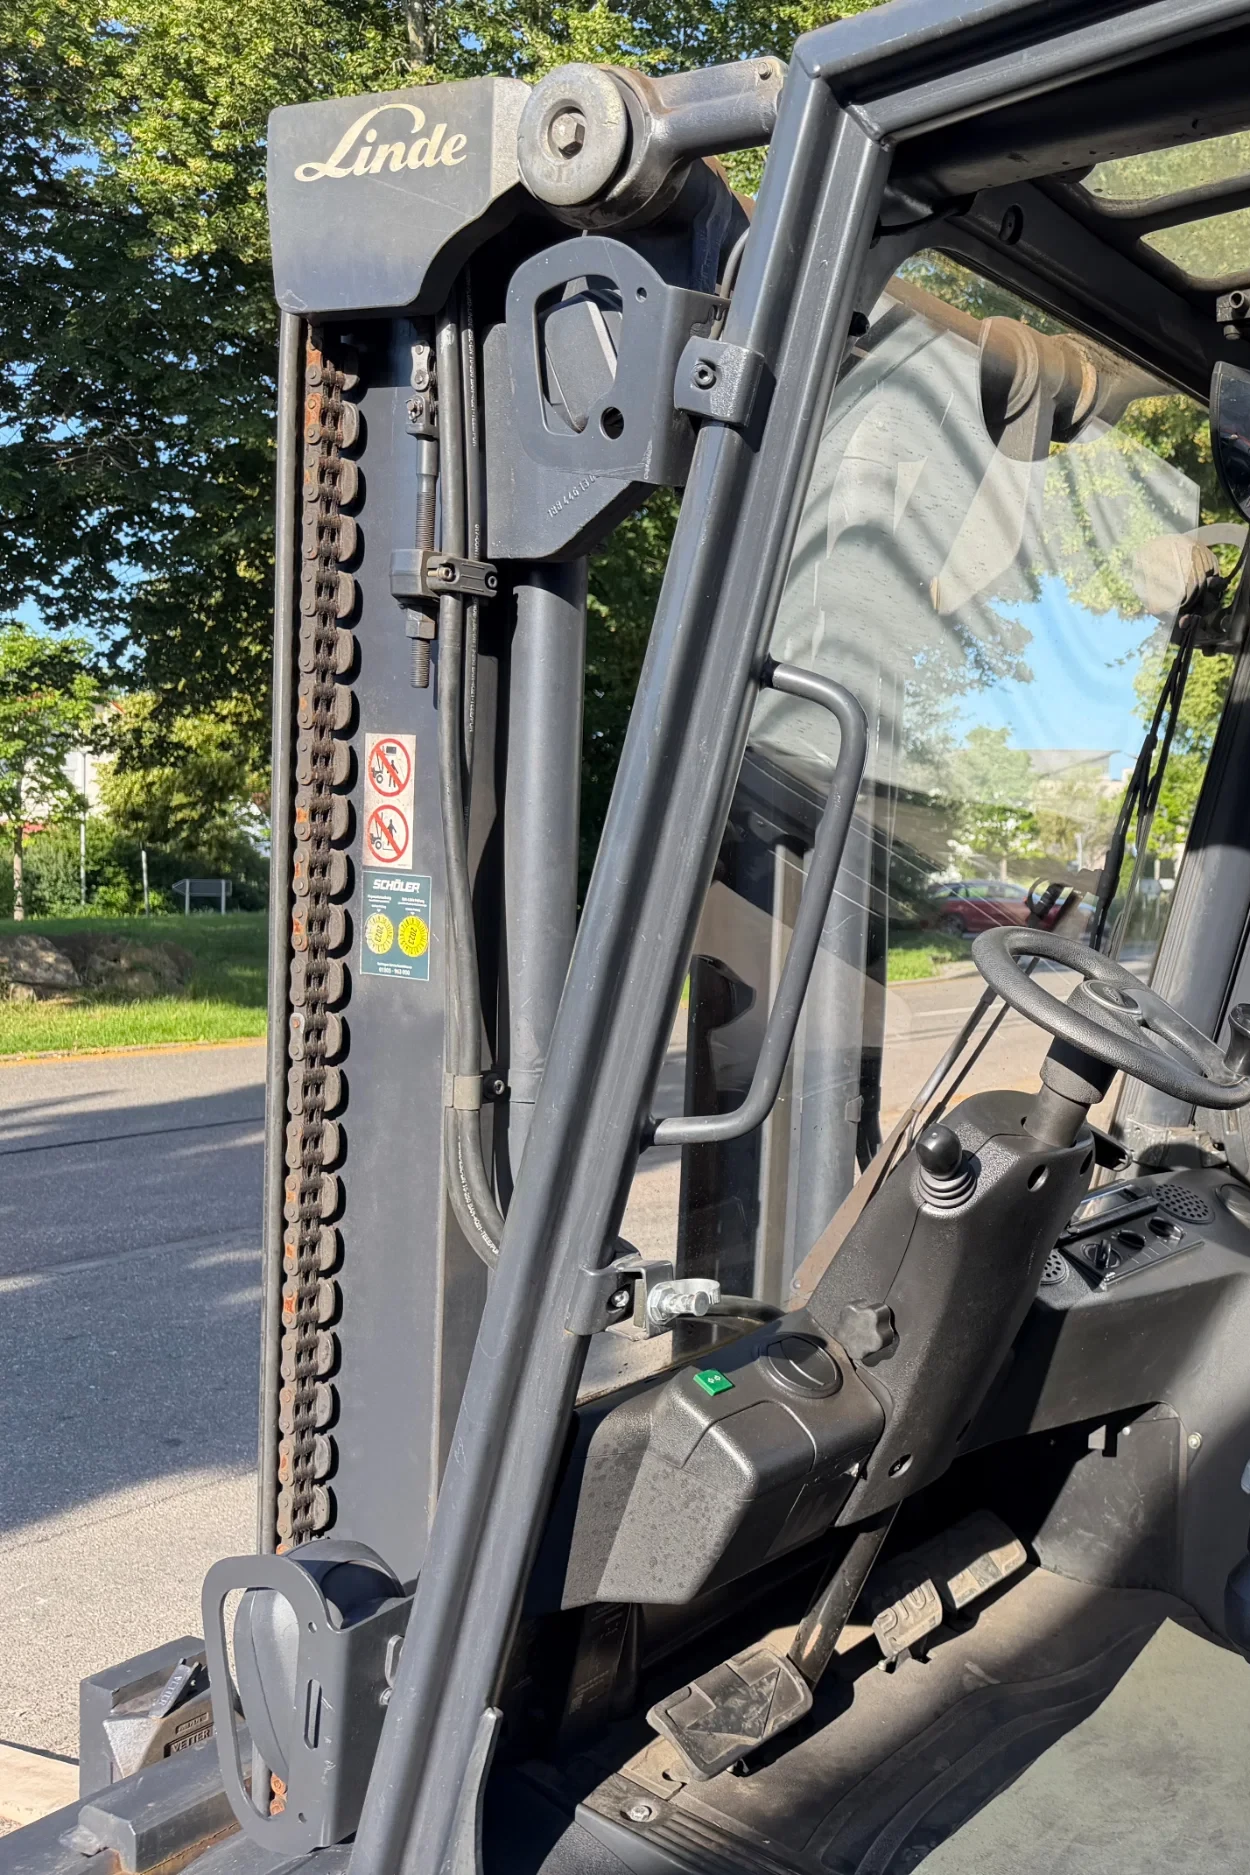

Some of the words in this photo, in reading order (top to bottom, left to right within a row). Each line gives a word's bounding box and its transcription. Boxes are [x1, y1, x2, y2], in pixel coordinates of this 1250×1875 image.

[294, 103, 467, 182] Linde
[372, 879, 420, 893] SCHÖLER
[407, 927, 418, 946] 2023
